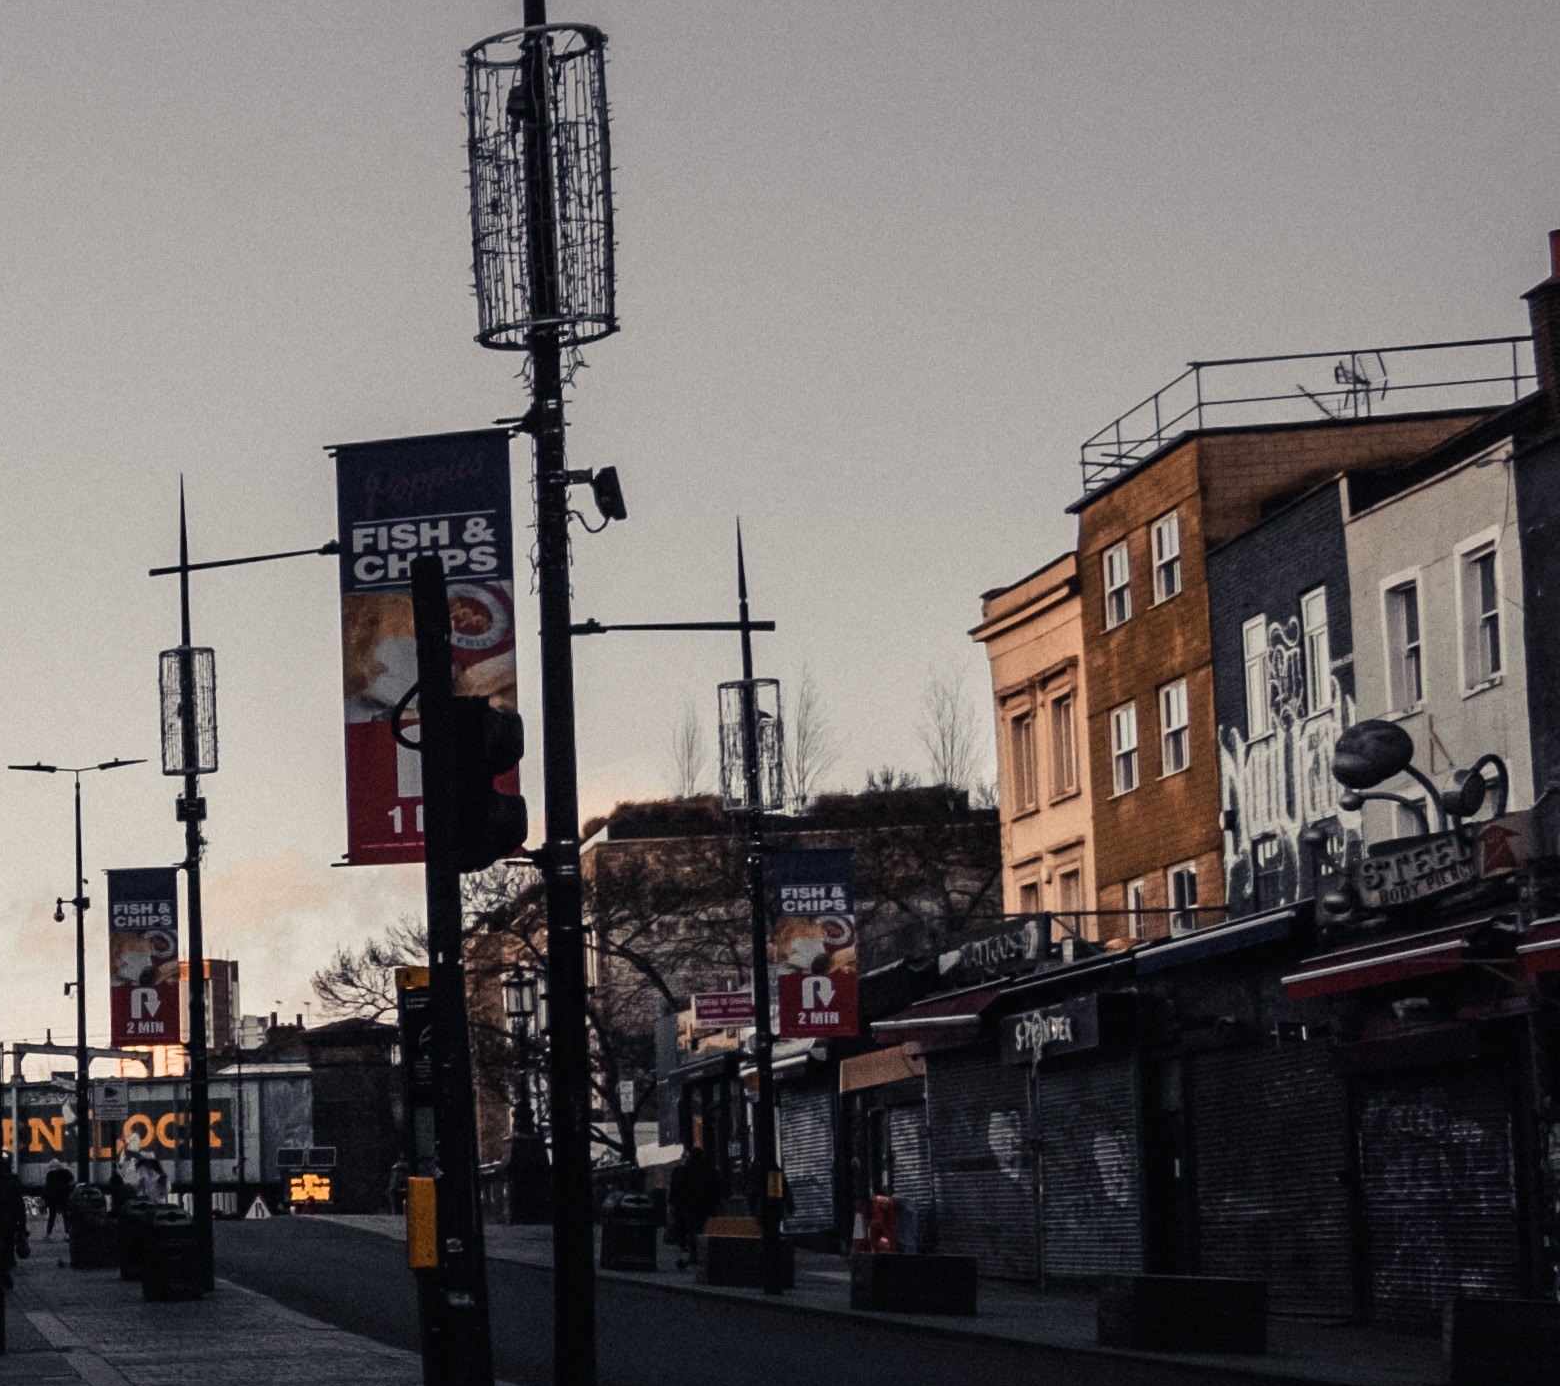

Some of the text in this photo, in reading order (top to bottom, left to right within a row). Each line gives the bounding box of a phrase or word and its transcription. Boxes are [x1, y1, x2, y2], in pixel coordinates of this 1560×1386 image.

[352, 517, 497, 553] FISH &
[354, 546, 498, 581] CHPS
[781, 886, 847, 899] FISH &
[113, 902, 170, 915] FISH &
[782, 899, 847, 912] CHIPS
[113, 915, 172, 927] CHIPS
[798, 1012, 839, 1025] 2 MIN
[126, 1021, 165, 1034] 2 MIN
